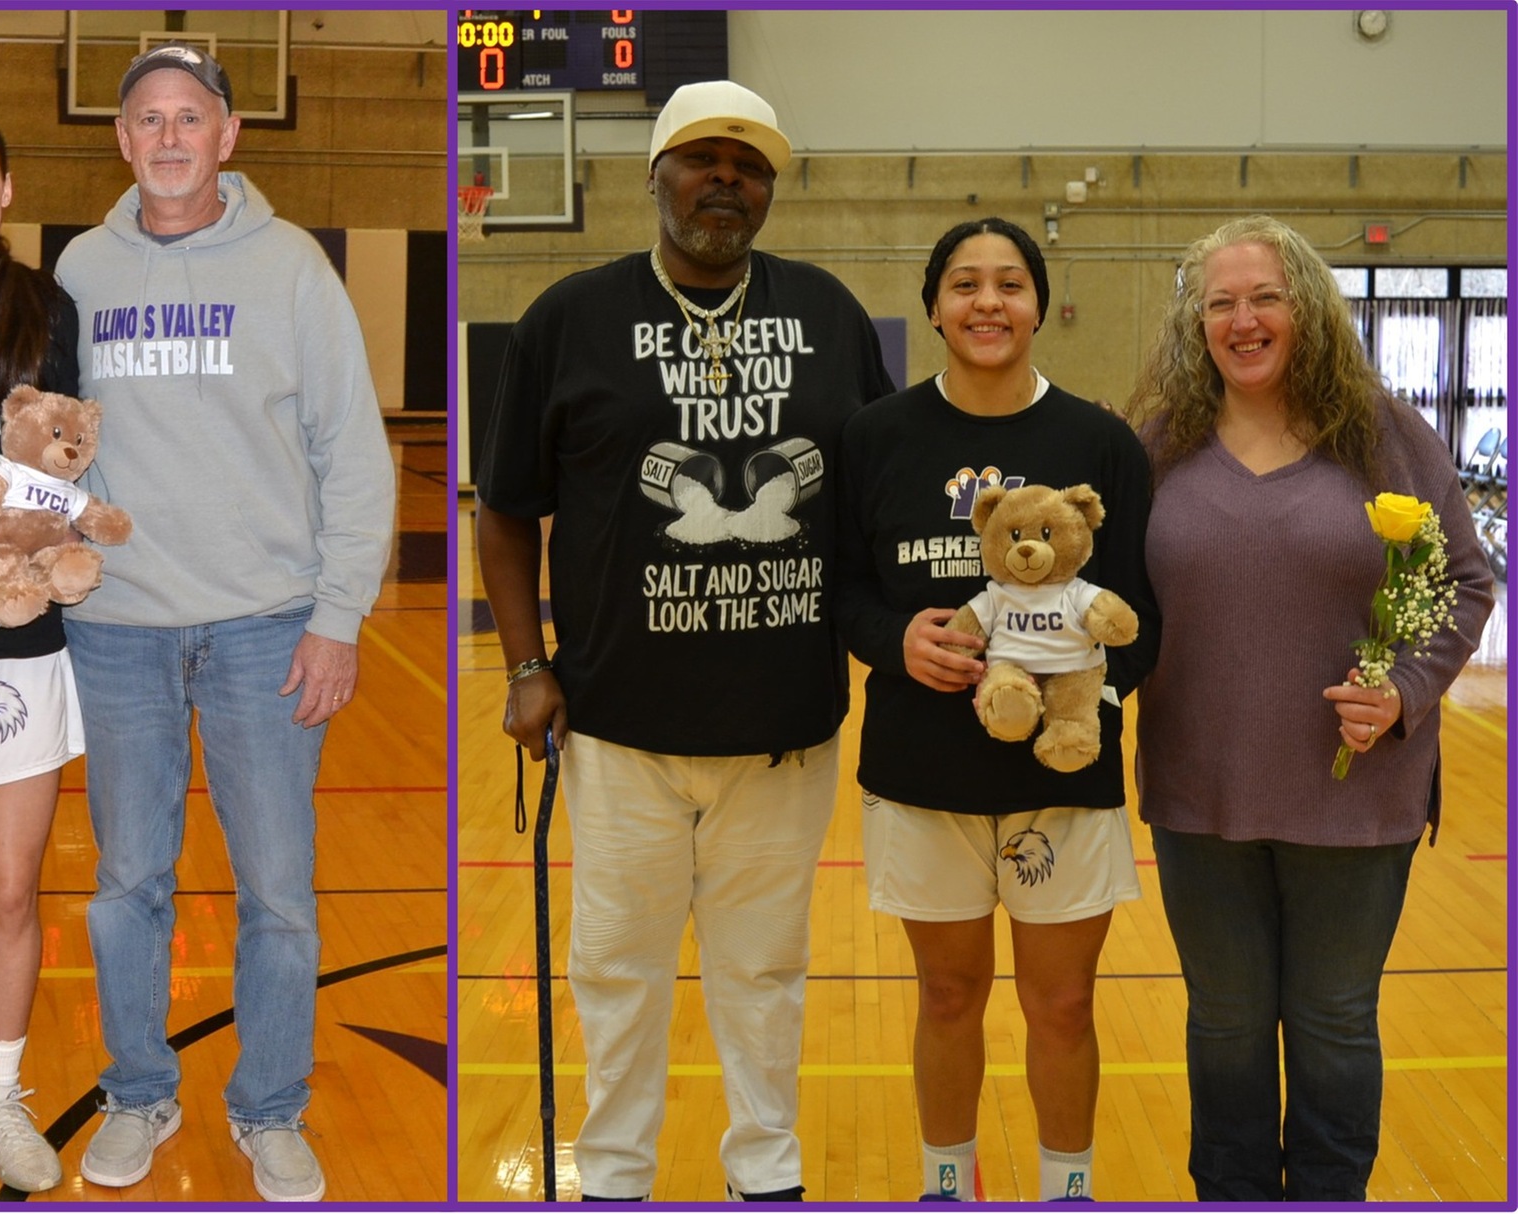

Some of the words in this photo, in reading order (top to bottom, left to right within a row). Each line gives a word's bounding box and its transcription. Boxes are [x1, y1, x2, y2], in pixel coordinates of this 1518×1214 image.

[457, 22, 514, 48] 0:00
[541, 27, 569, 40] FOUL
[601, 27, 636, 39] FOULS
[615, 40, 633, 68] 0
[479, 48, 504, 90] 0
[523, 74, 551, 86] ATCH
[602, 73, 637, 85] SCORE
[634, 322, 675, 360] BE
[681, 317, 814, 360] CAREFUL
[92, 339, 234, 380] BASKETBALL
[659, 360, 728, 396] WHO
[734, 355, 792, 394] YOU
[672, 391, 789, 441] TRUST
[643, 459, 672, 484] SALT
[797, 453, 823, 481] SUGAR
[897, 536, 982, 564] BASKE
[643, 564, 703, 597] SALT
[705, 563, 753, 597] AND
[756, 557, 823, 593] SUGAR
[931, 559, 981, 578] ILLINOIS
[648, 599, 709, 633] LOOK
[715, 597, 761, 631] THE
[765, 591, 822, 628] SAME
[1007, 611, 1063, 632] IVCC
